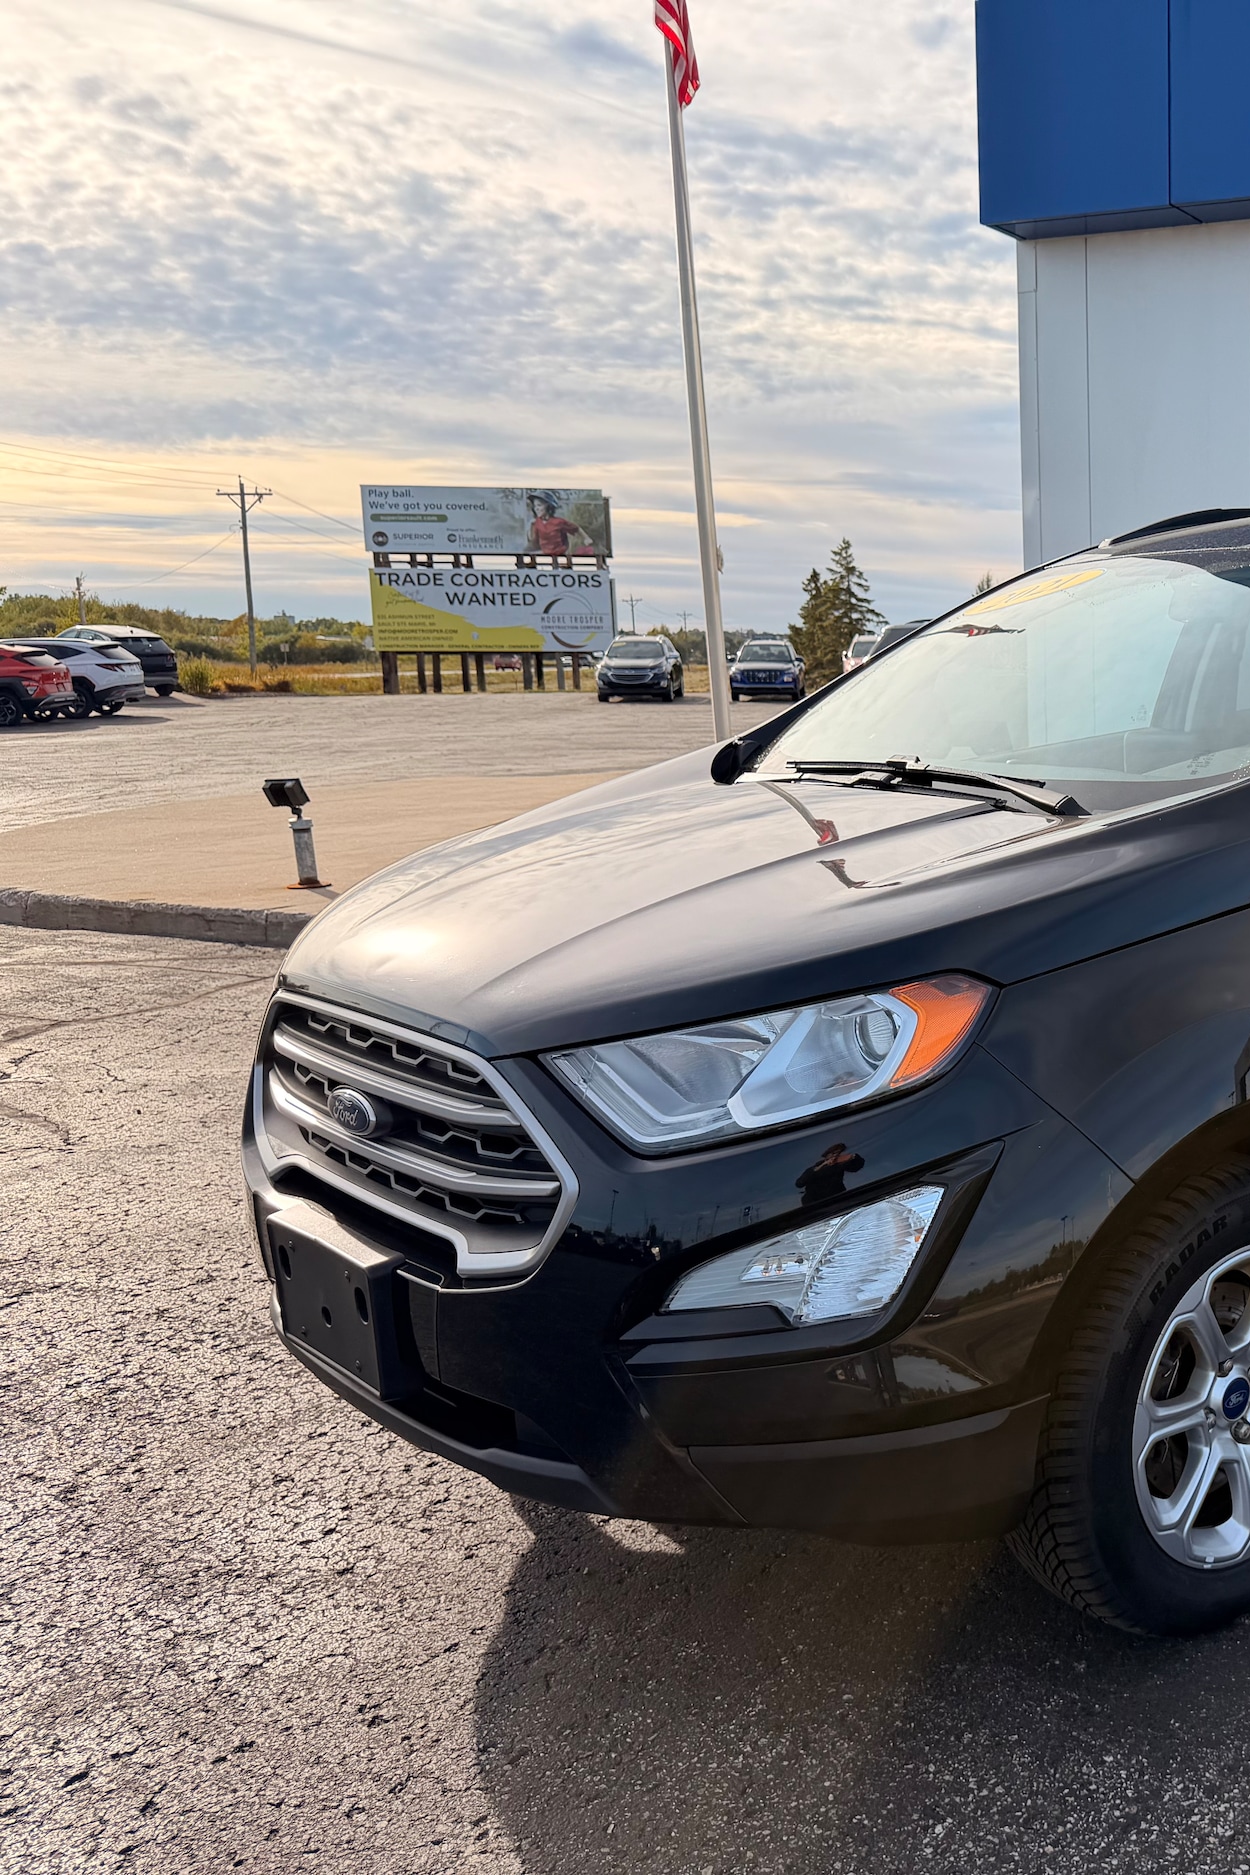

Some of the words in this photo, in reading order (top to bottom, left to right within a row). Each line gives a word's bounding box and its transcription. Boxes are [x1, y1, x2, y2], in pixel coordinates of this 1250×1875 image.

[368, 489, 391, 499] Play
[392, 489, 414, 498] ball.
[368, 501, 401, 510] We've
[403, 502, 421, 512] got
[424, 503, 442, 512] you
[445, 501, 489, 511] covered.
[392, 532, 434, 541] SUPERIOR
[375, 572, 445, 587] TRADE
[450, 573, 602, 588] CONTRACTORS
[445, 592, 537, 606] WANTED
[540, 616, 567, 624] MOORE
[569, 615, 604, 624] TROSPER
[333, 1097, 358, 1126] Ford
[1149, 1214, 1229, 1306] RADAR
[1225, 1393, 1247, 1408] Ford
